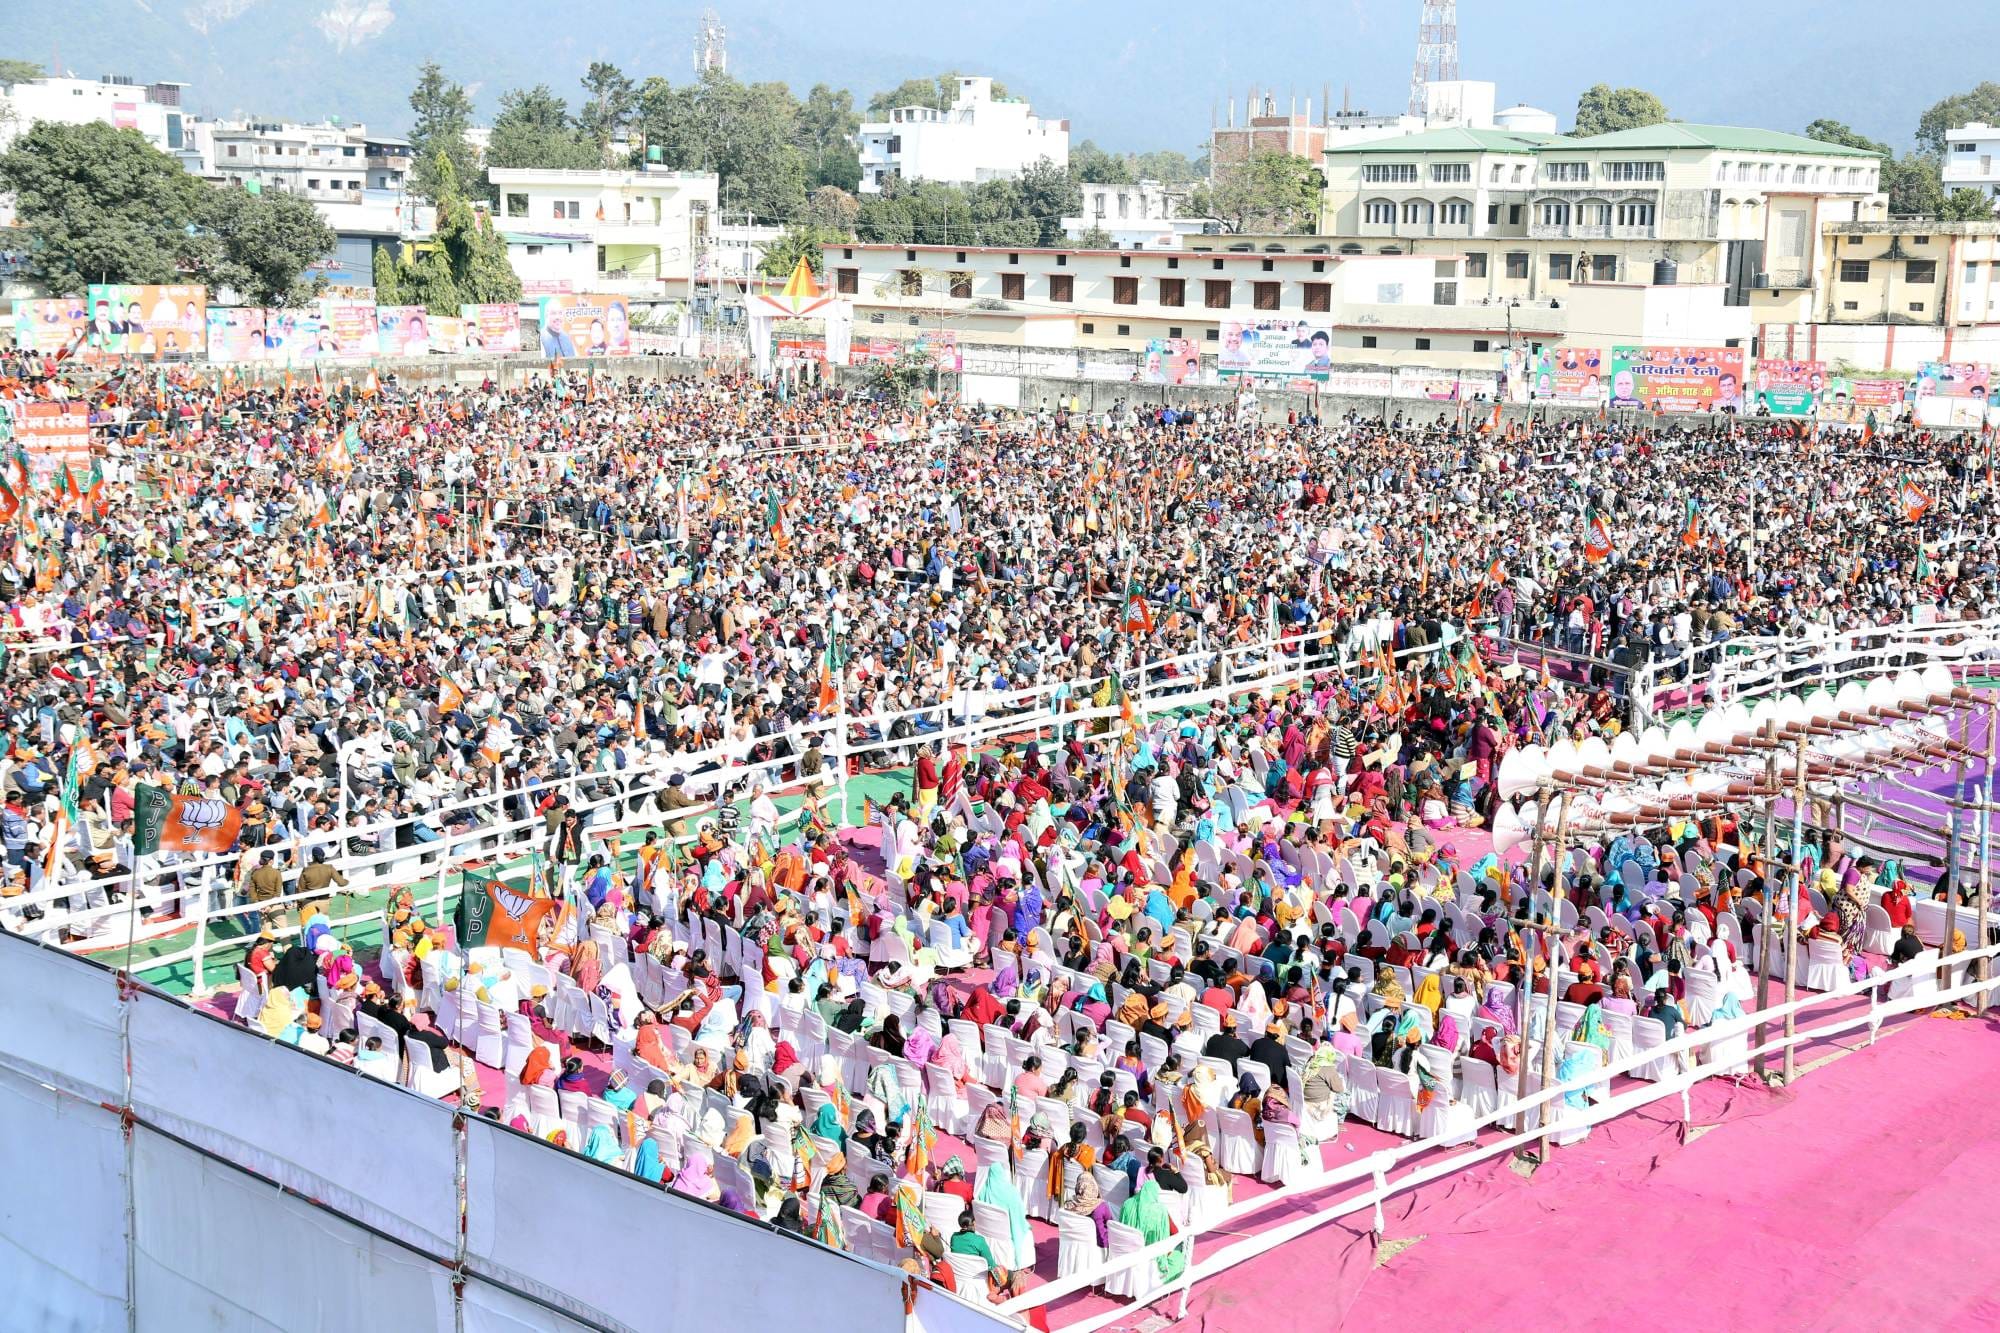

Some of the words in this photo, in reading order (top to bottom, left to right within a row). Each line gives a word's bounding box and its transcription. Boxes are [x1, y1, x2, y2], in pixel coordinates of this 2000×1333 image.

[1630, 364, 1686, 376] परिवर्तन
[1655, 385, 1680, 396] अमित
[1701, 386, 1713, 397] जी
[146, 790, 168, 849] BJP
